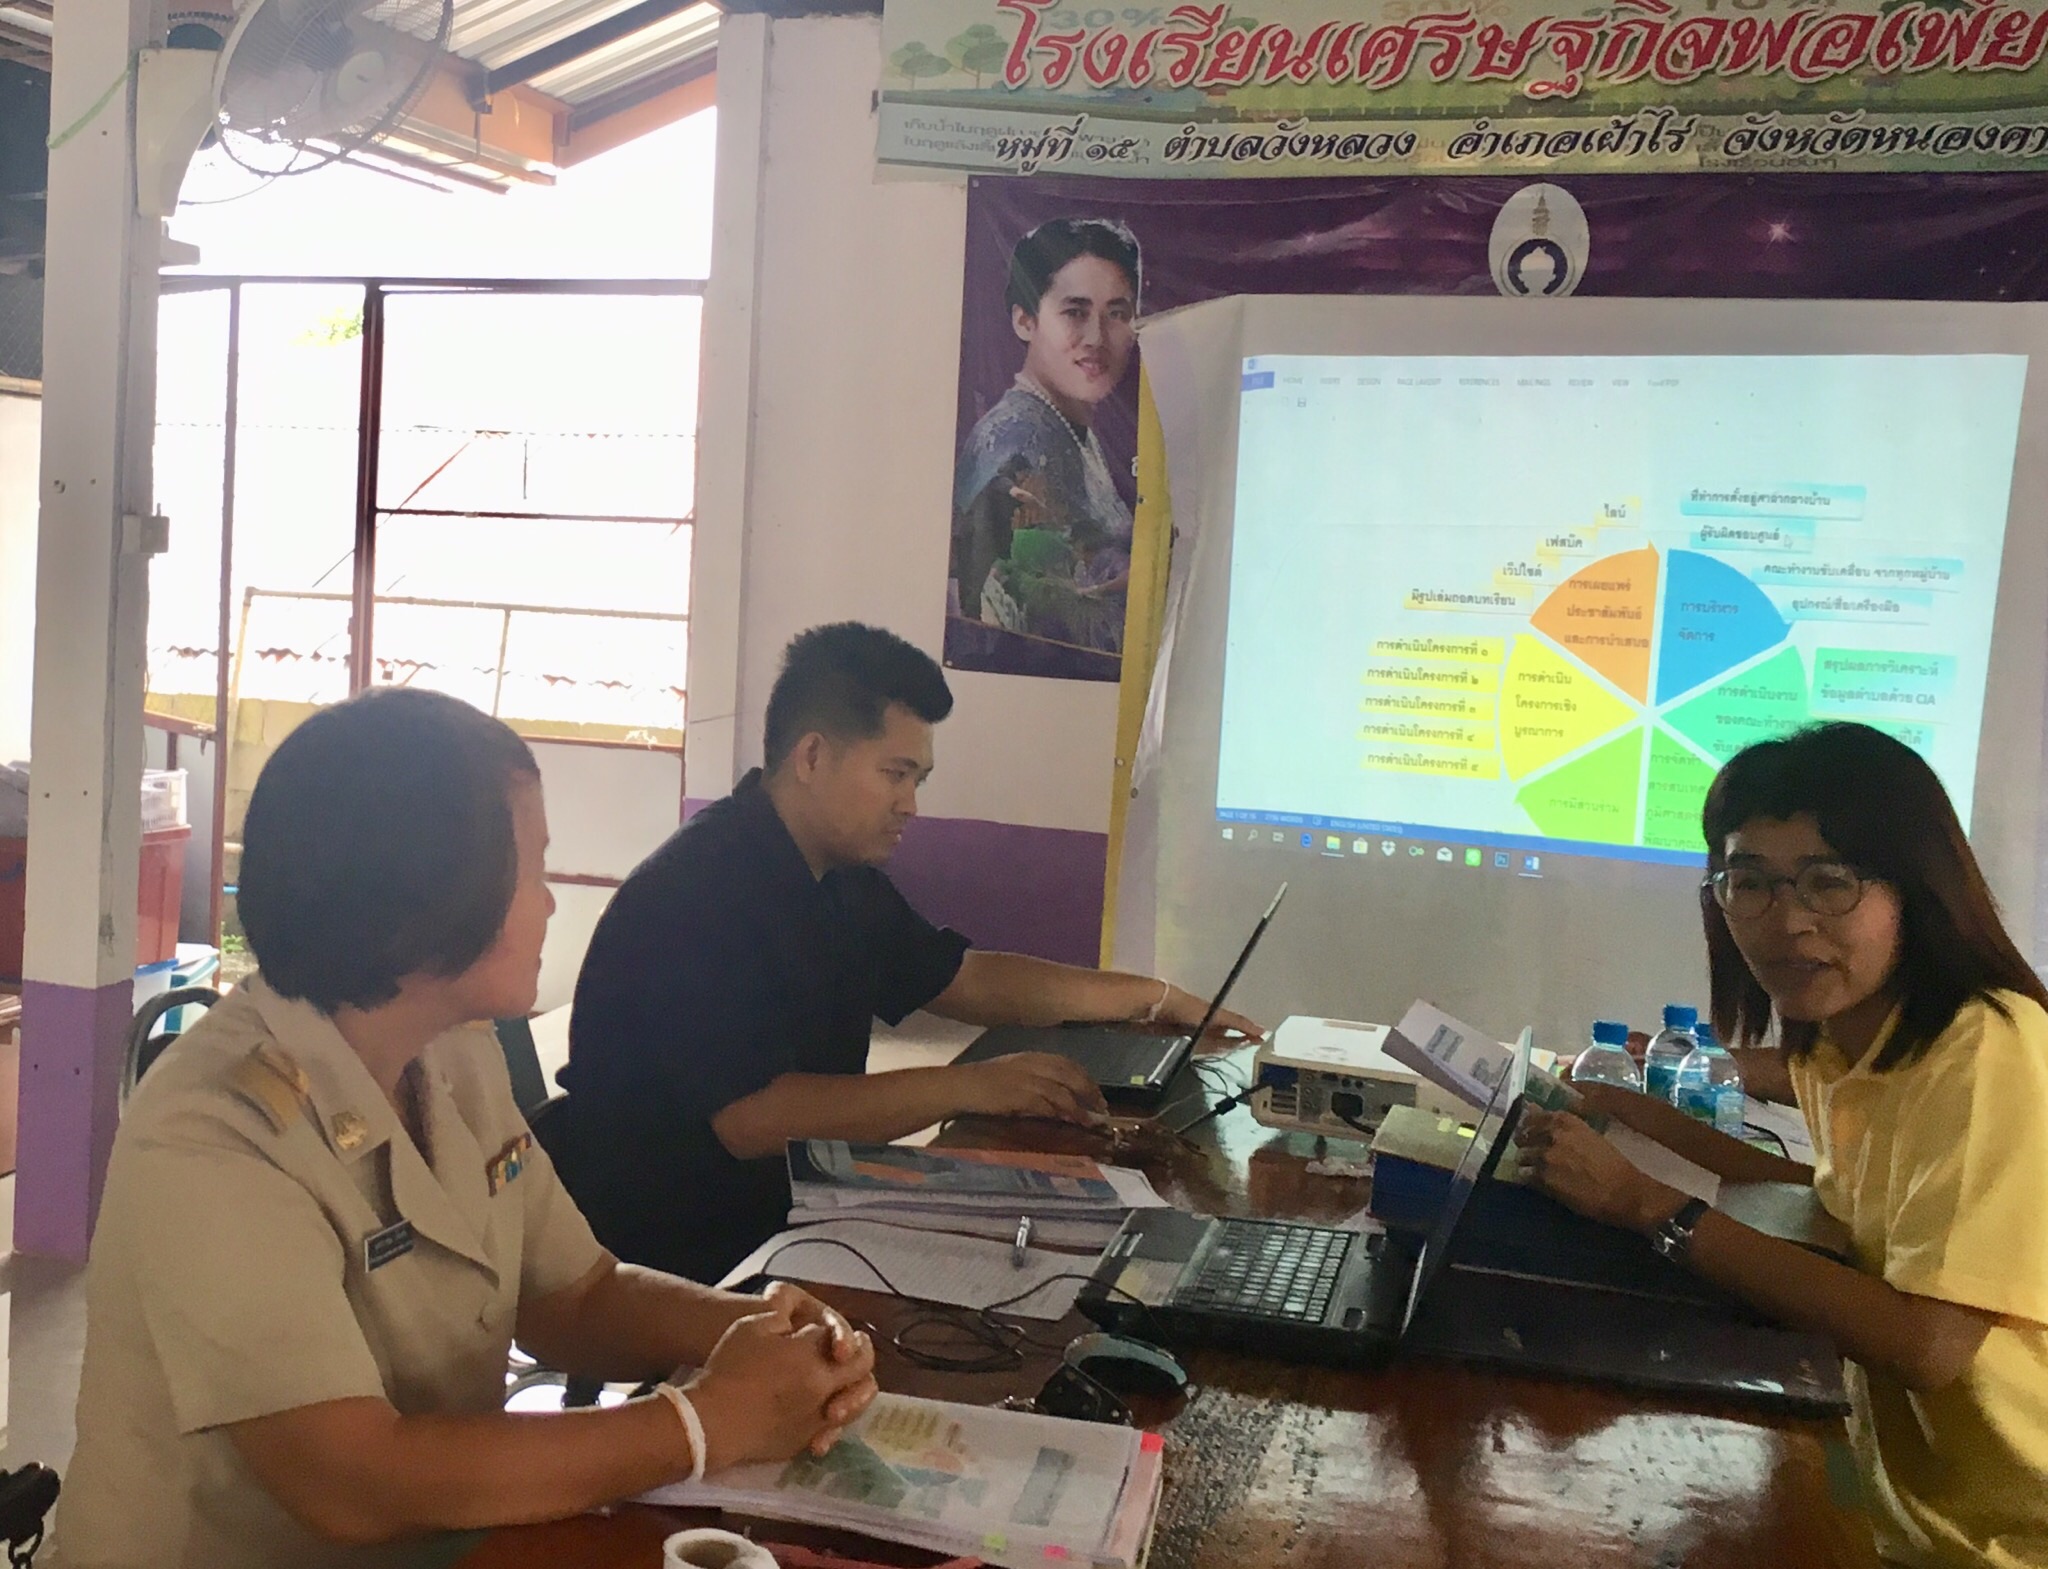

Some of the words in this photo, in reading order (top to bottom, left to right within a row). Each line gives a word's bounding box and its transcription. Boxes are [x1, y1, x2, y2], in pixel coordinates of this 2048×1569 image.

[997, 116, 1083, 172] หมู่ที่
[1086, 138, 1139, 160] ๑๕
[1164, 123, 1416, 161] ตำบลวังหลวง
[1449, 110, 1696, 159] อำเภอเฝ้าไร่
